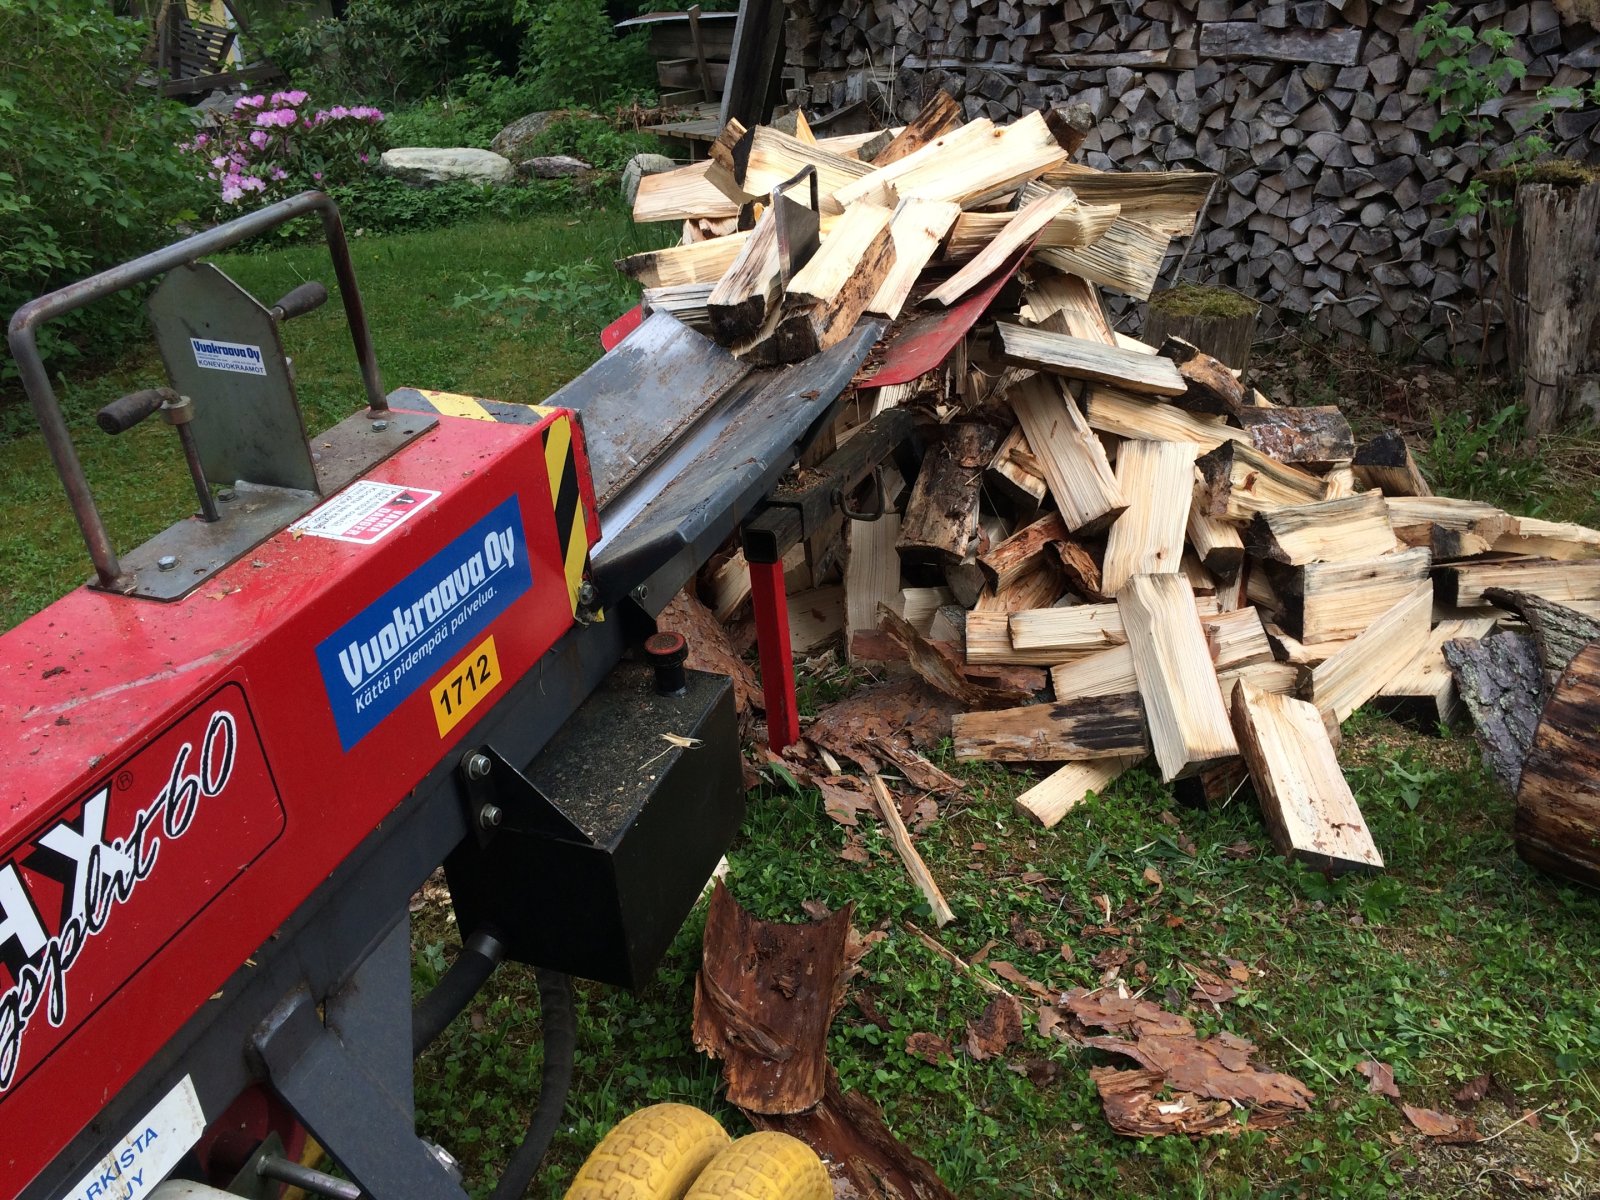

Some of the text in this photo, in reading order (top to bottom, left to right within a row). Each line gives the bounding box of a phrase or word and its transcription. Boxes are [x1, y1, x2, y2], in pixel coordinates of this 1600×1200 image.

[193, 341, 246, 358] Vuokraava
[246, 347, 260, 363] Oy
[198, 360, 264, 374] KONEVUOKRAAMOT
[345, 507, 391, 536] DANGER
[367, 509, 406, 532] VAARA
[338, 526, 515, 689] Vuokraava Oy
[355, 587, 498, 714] Kättä pidempää palvelua.
[439, 654, 491, 716] 1712
[163, 711, 237, 839] 60
[78, 1128, 159, 1200] RKISTA
